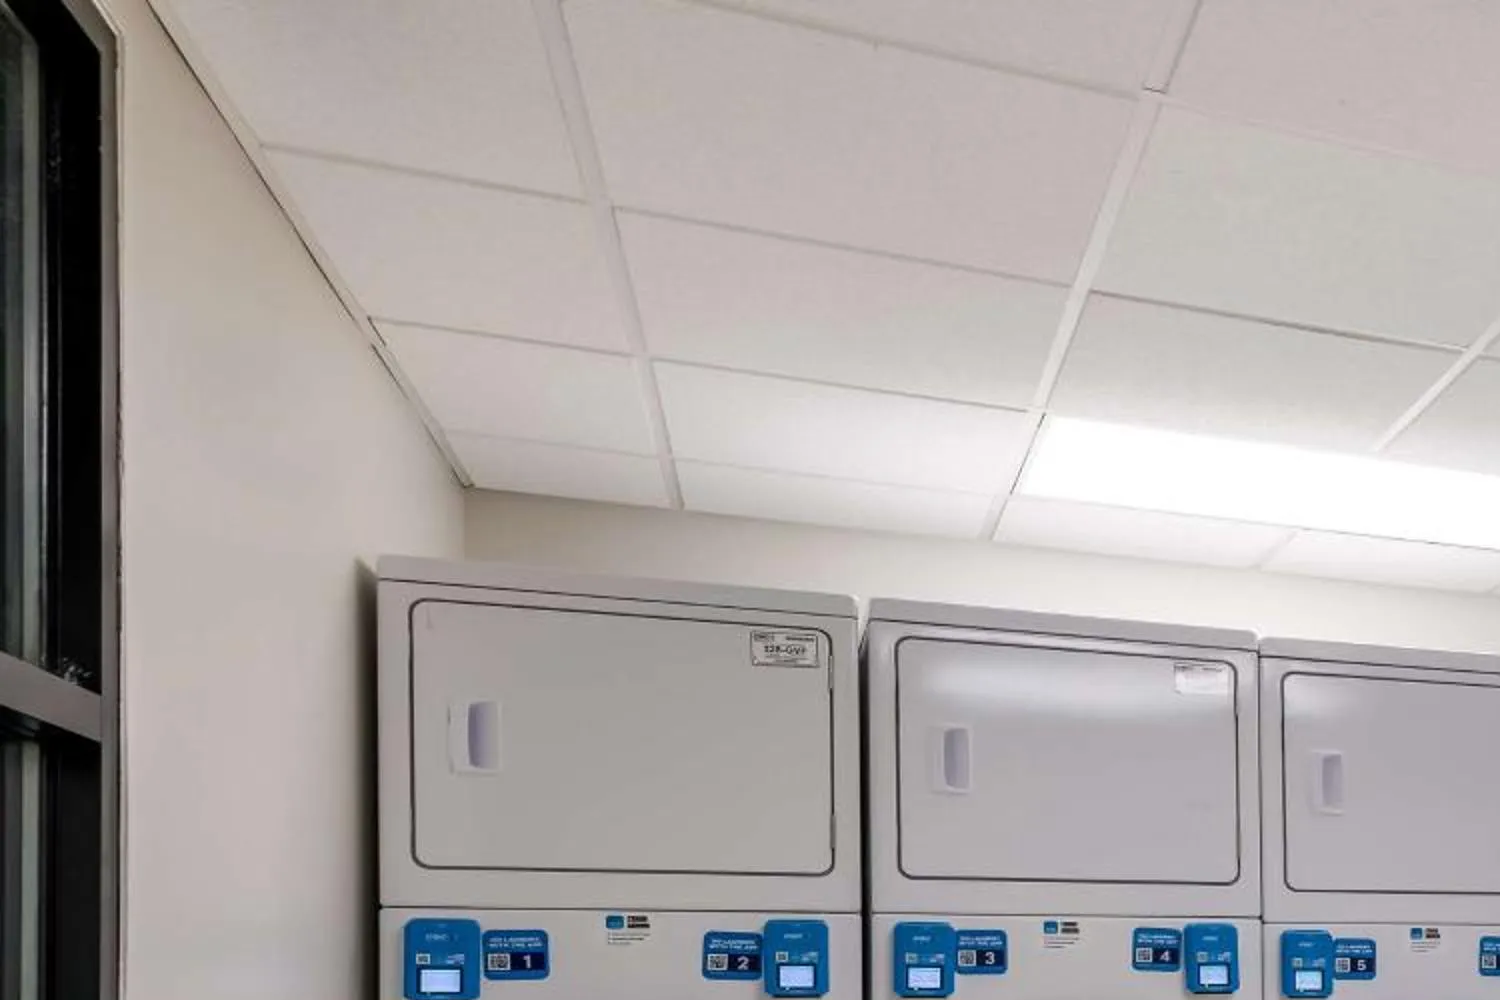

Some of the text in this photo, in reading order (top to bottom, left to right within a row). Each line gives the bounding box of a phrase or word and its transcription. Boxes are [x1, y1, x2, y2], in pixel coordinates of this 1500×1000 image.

[523, 954, 531, 969] 1
[737, 955, 750, 970] 2
[984, 951, 995, 965] 3
[1160, 950, 1171, 962] 4
[1357, 959, 1367, 971] 5
